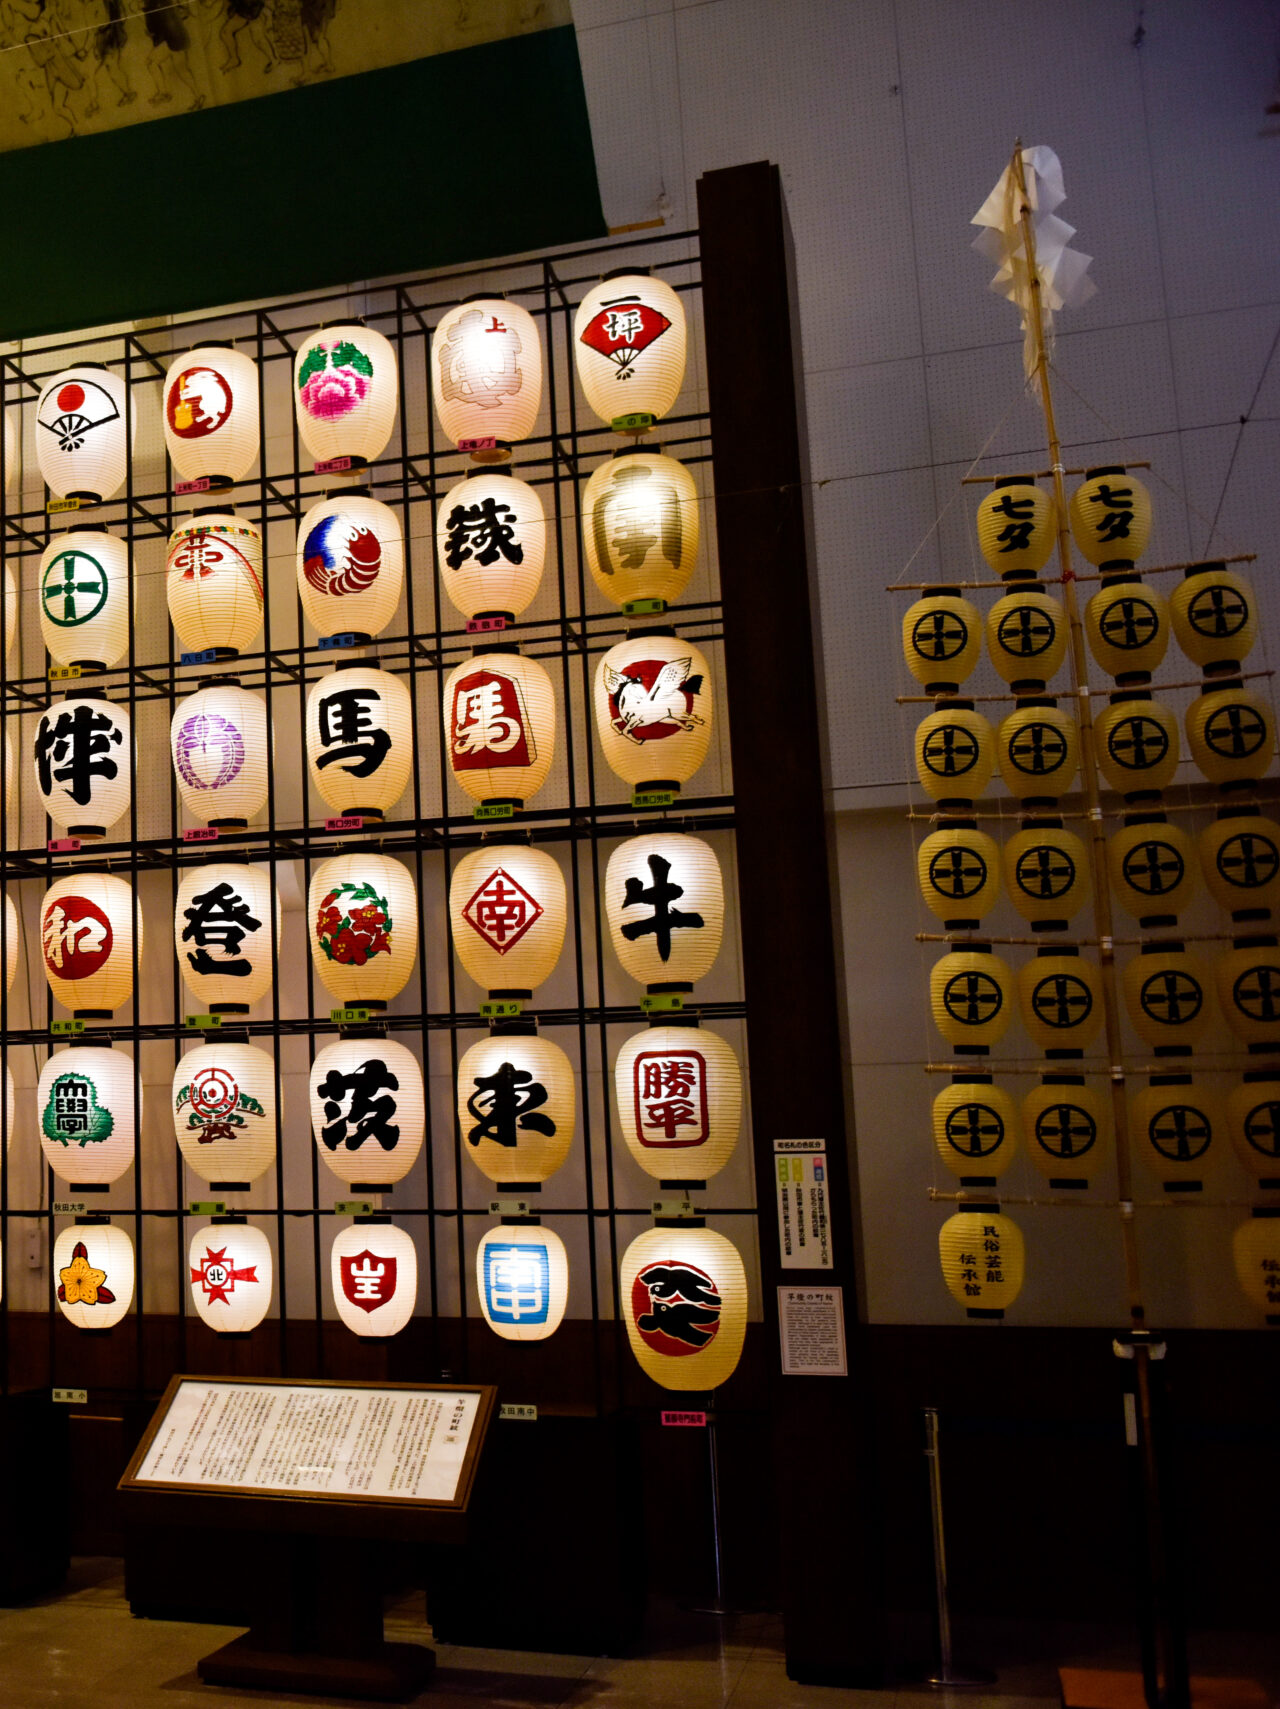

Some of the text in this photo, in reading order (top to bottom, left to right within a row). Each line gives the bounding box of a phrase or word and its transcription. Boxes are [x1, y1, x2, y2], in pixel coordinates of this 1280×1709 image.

[992, 495, 1035, 553] 七夕
[1090, 485, 1134, 543] 七夕
[51, 668, 79, 678] 秋田市
[317, 689, 393, 779] 馬
[183, 883, 263, 977] 登
[620, 854, 705, 963] 牛
[467, 1062, 557, 1147] 東
[641, 1060, 696, 1140] 勝平
[54, 1203, 85, 1212] 秋田大学
[959, 1254, 982, 1297] 伝承館
[984, 1226, 1004, 1282] 民俗芸能
